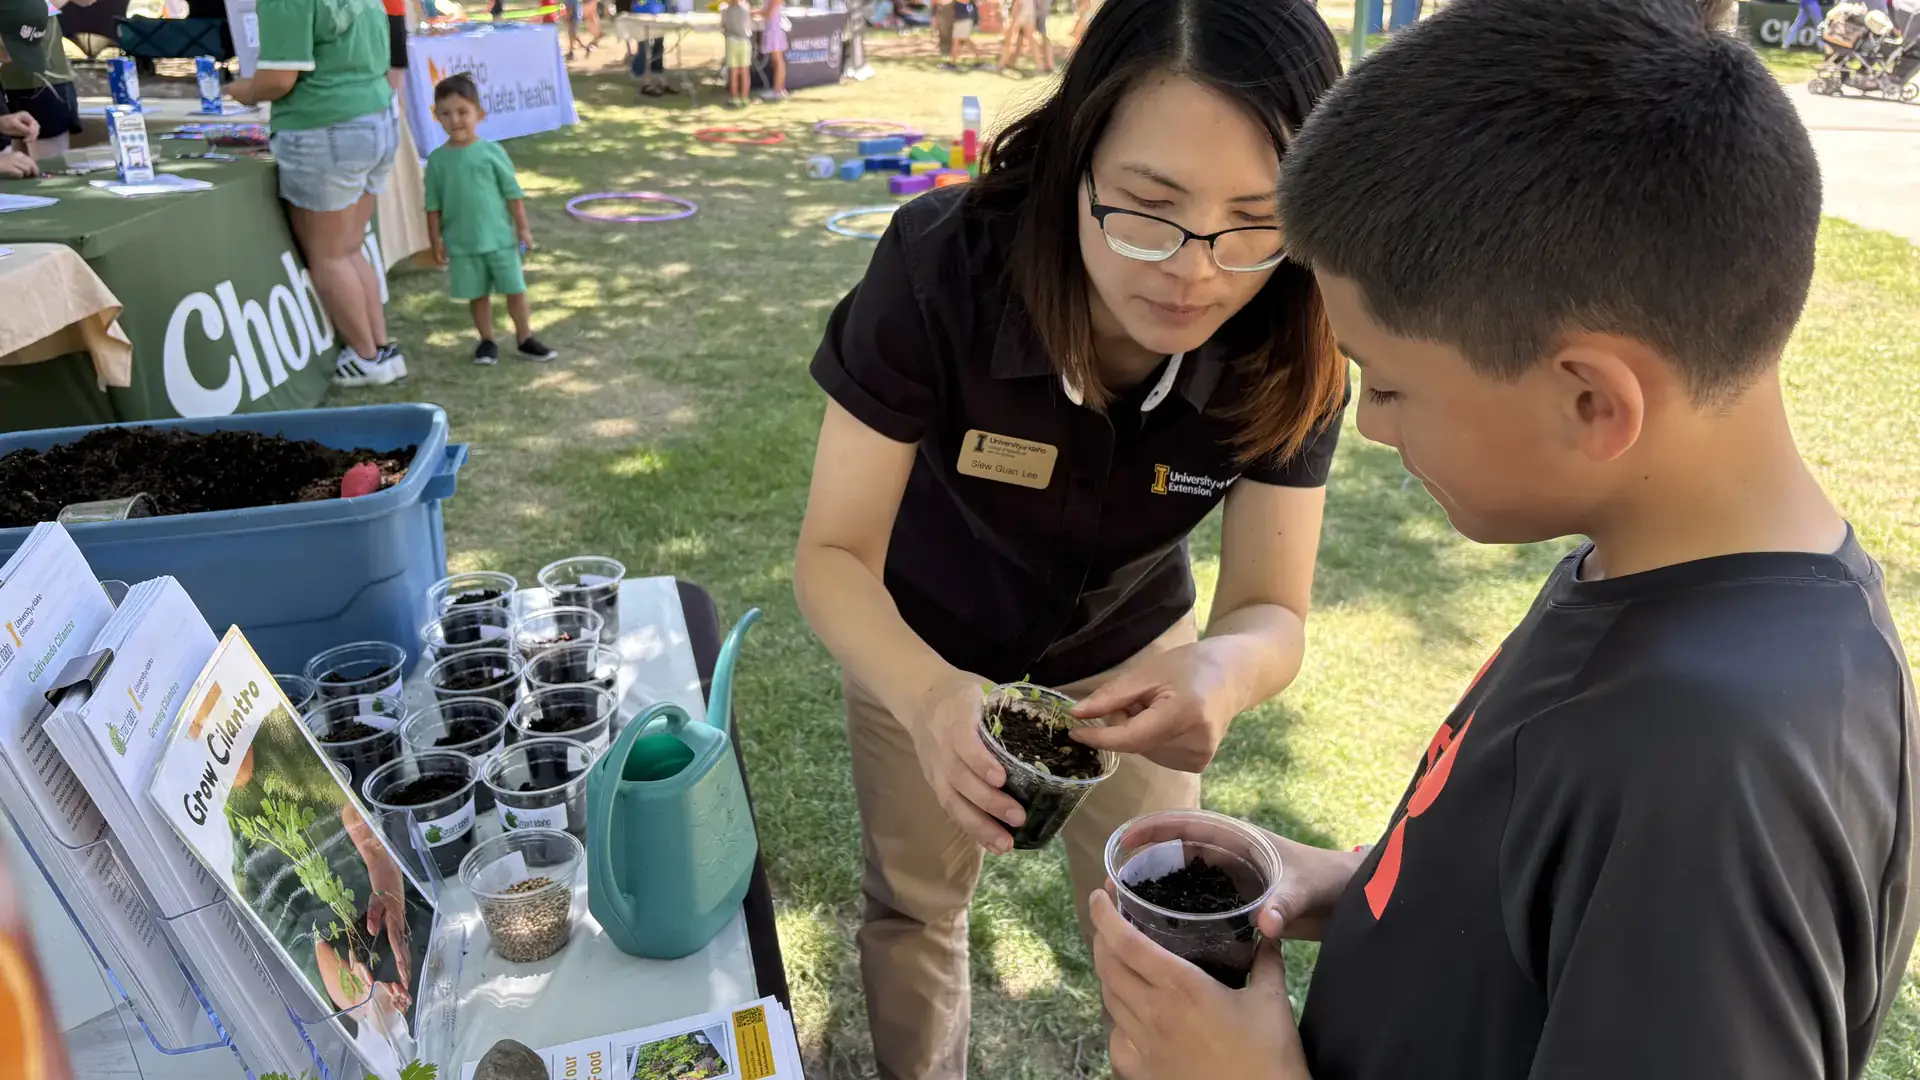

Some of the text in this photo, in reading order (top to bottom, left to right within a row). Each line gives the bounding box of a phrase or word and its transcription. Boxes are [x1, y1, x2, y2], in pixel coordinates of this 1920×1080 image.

[518, 79, 557, 111] health
[990, 437, 1024, 450] University
[1028, 444, 1046, 454] Idaho
[971, 460, 1038, 480] Siew Guan Lee
[1170, 472, 1216, 490] University
[1216, 481, 1226, 490] of
[1168, 482, 1212, 497] Extension
[28, 620, 75, 683] Cultivando Cilantro
[148, 682, 180, 738] Growing Cilantro
[184, 761, 218, 826] Grow
[206, 680, 260, 766] Cilantro
[534, 818, 551, 828] Idaho
[564, 1051, 602, 1080] our Food
